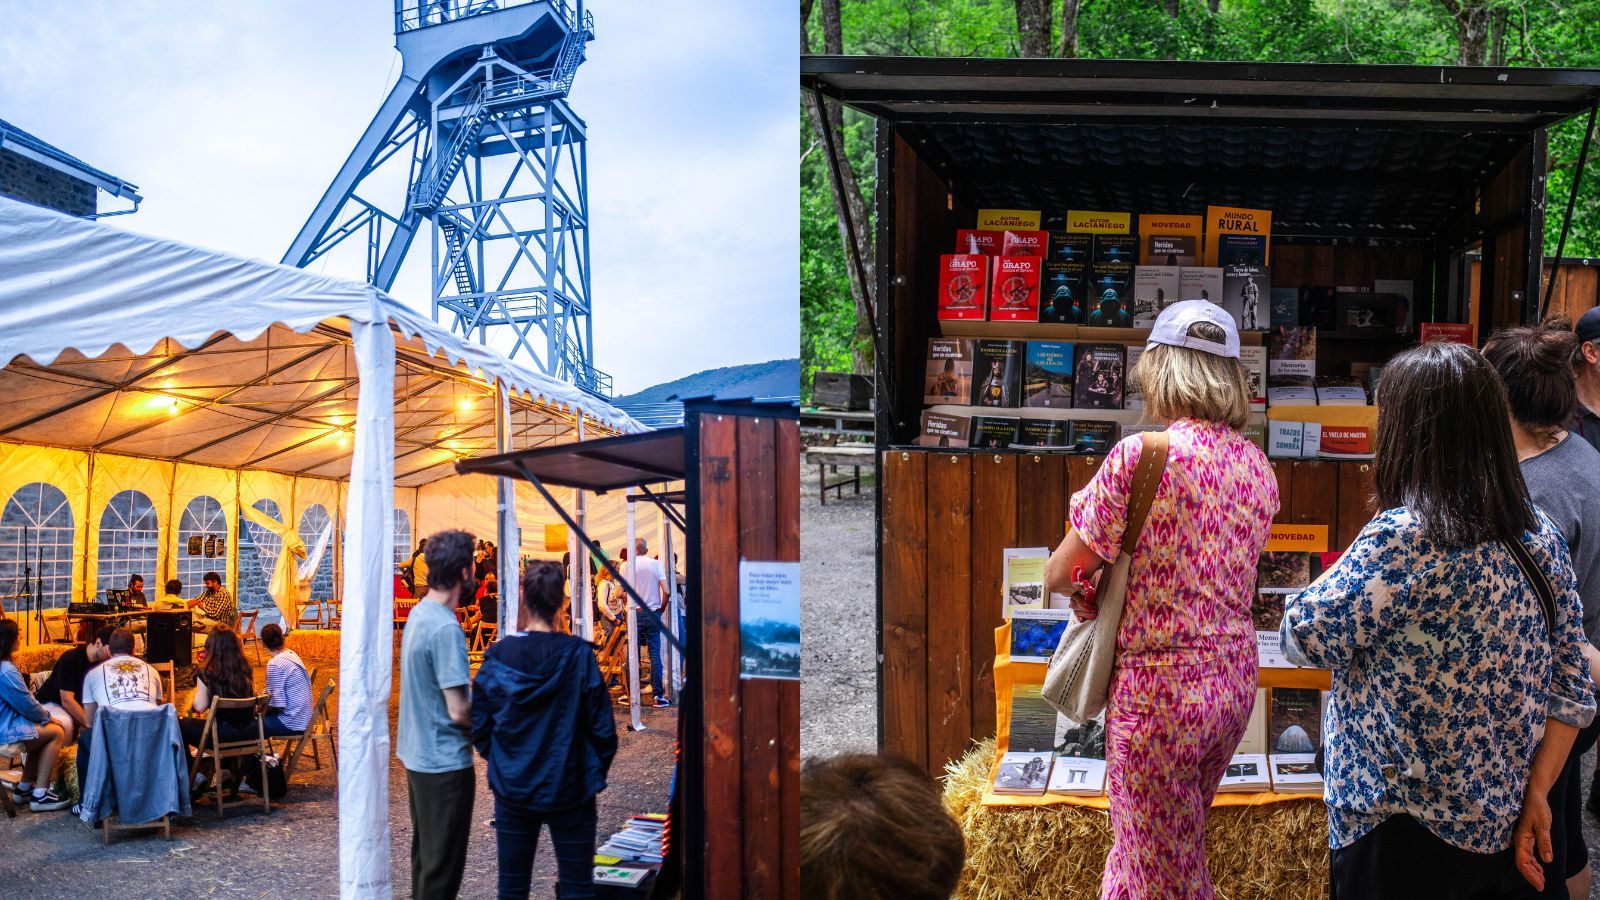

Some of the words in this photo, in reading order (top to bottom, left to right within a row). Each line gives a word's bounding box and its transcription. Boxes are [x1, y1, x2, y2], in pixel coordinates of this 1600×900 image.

[1224, 212, 1254, 220] MUNDO
[984, 220, 1035, 228] LACIANIEGO
[1218, 219, 1259, 232] RURAL
[1011, 236, 1038, 244] GRAPO
[927, 420, 948, 429] Heridas
[1279, 428, 1300, 436] TRAZOS
[1350, 431, 1366, 439] MARTÍN
[1276, 442, 1300, 450] SOMBRA
[1271, 533, 1315, 541] NOVEDAD
